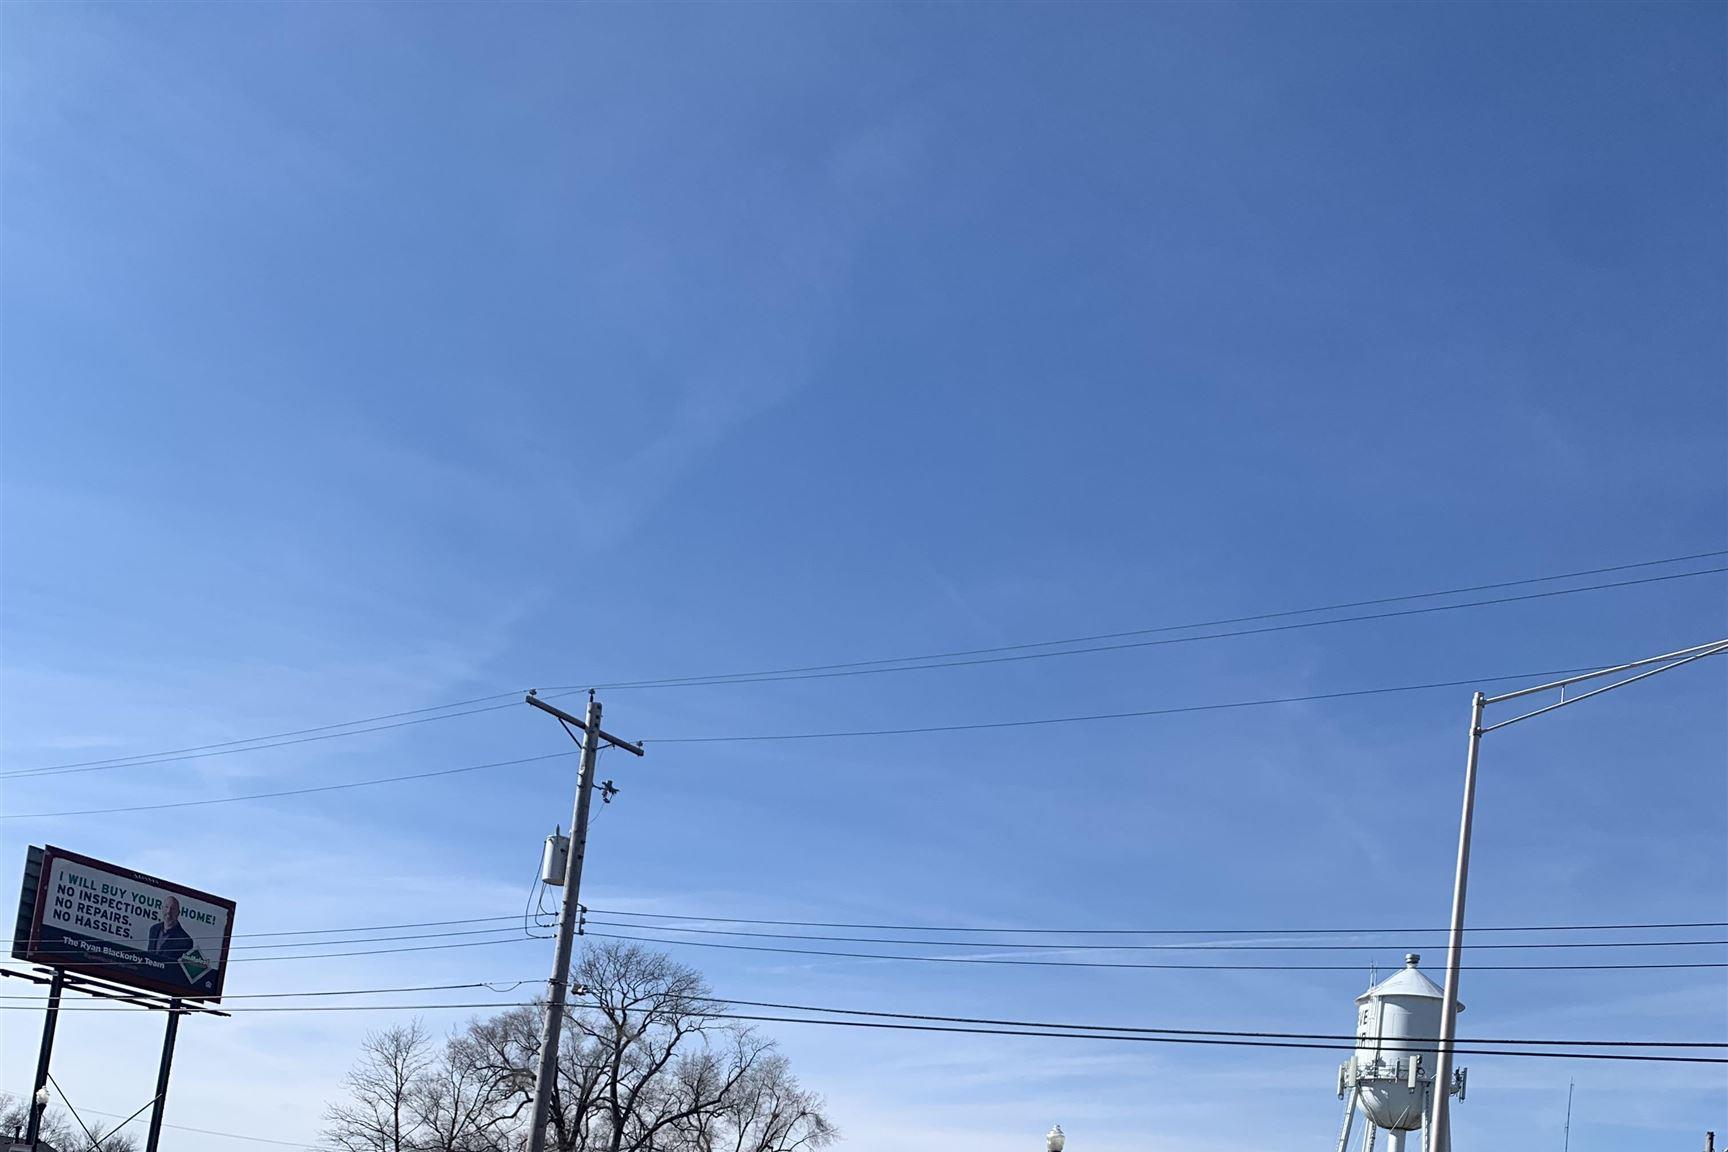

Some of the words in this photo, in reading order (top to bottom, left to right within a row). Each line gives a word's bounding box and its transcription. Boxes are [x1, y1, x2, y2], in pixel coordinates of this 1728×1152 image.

[55, 896, 73, 909] NO
[77, 902, 132, 926] REPAIRS.
[57, 884, 75, 897] NO
[79, 889, 161, 922] INSPECTIONS.
[60, 871, 63, 881] I
[69, 873, 97, 891] WILL
[101, 884, 127, 899] BUY
[131, 892, 163, 910] YOUR
[181, 906, 216, 926] HOME!
[53, 908, 71, 922] NO
[75, 914, 133, 939] HASSLES.
[62, 936, 79, 947] The
[80, 941, 101, 953] Ryan
[103, 946, 143, 964] Blackorby
[144, 957, 165, 969] Team
